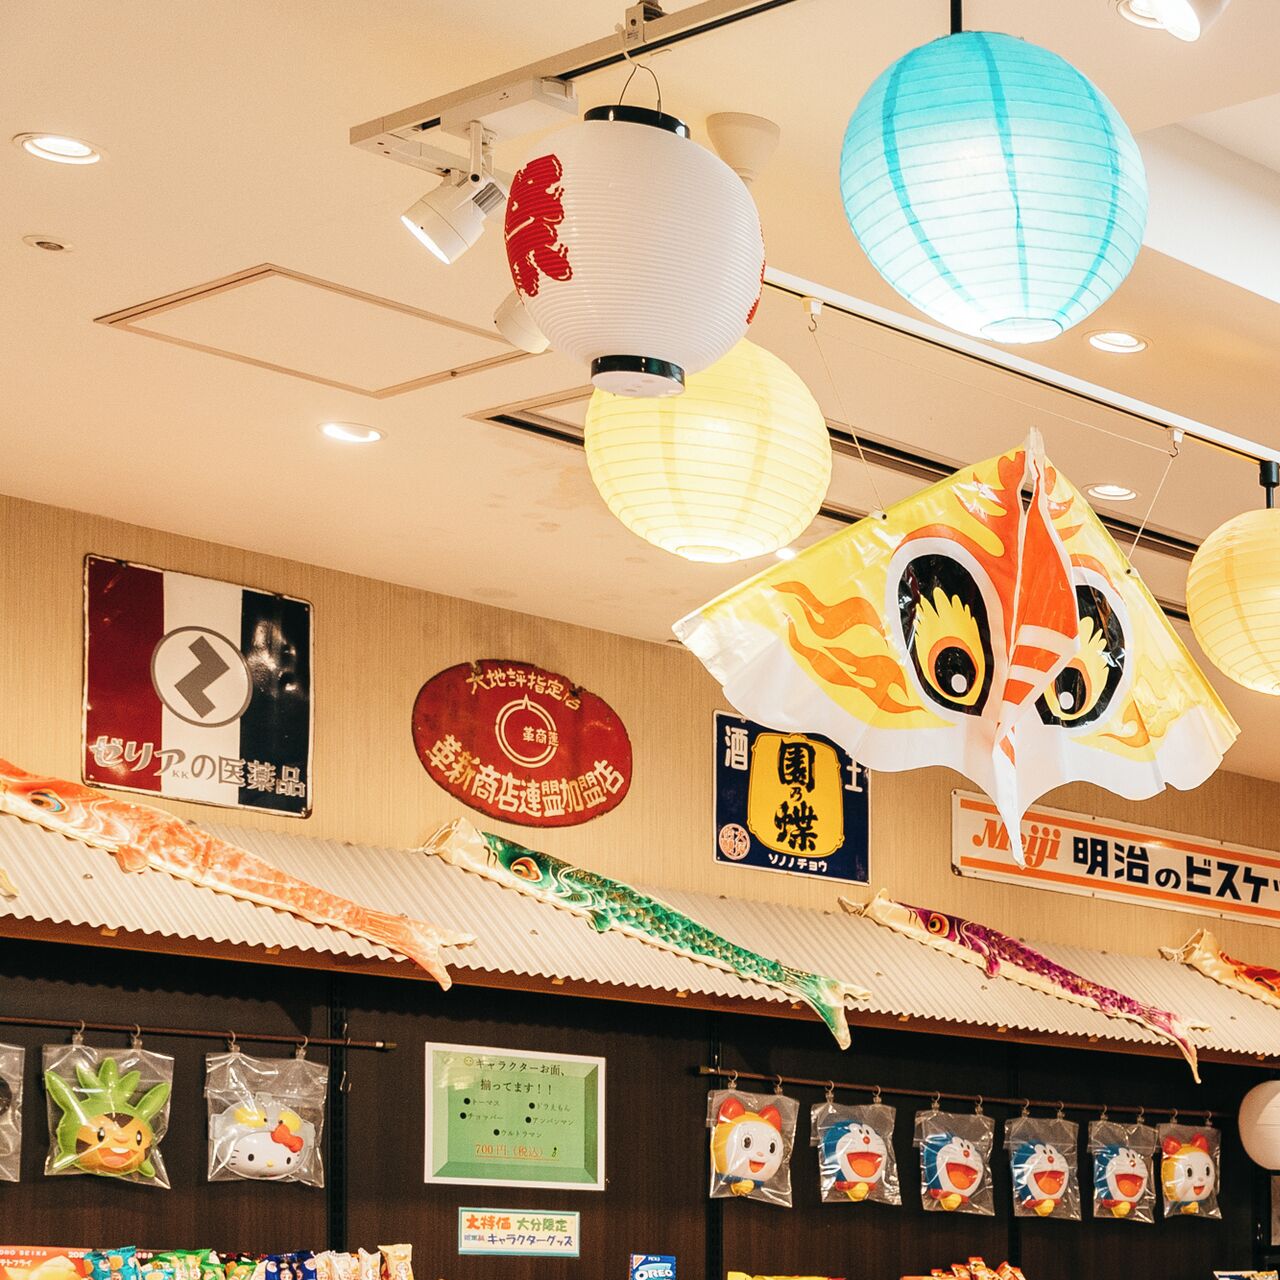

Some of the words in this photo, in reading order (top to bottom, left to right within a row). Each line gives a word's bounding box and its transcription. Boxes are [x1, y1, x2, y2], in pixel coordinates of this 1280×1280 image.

[724, 725, 749, 771] 酒
[425, 734, 625, 817] 革新商店連盟加盟店
[768, 853, 828, 873] ソノノチョウ
[466, 1214, 512, 1231] 大特価
[516, 1216, 569, 1232] 大分限定
[487, 1233, 574, 1248] キャラクターグッズ
